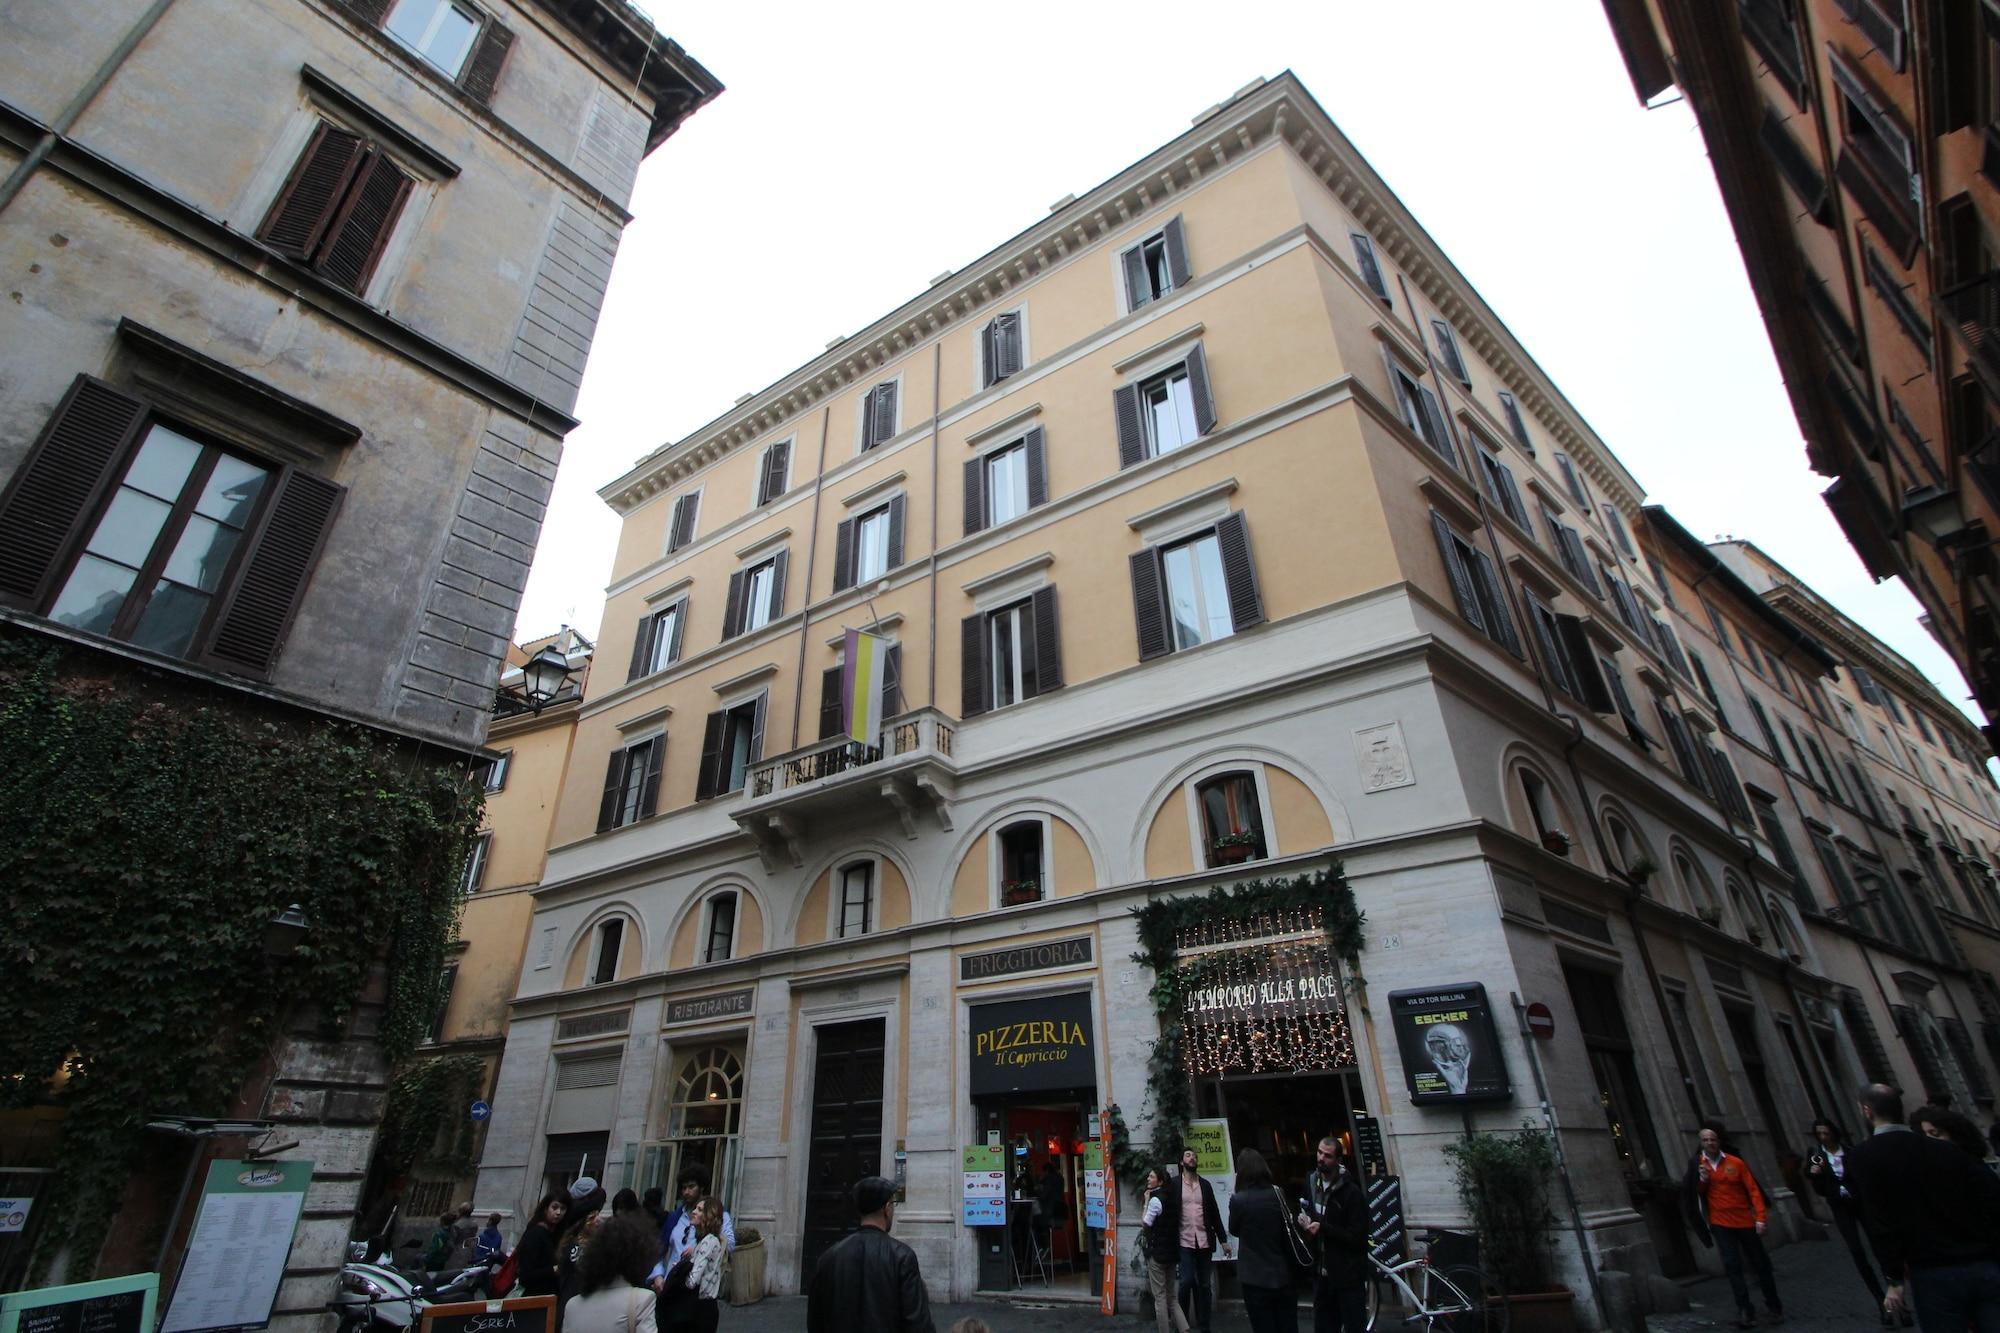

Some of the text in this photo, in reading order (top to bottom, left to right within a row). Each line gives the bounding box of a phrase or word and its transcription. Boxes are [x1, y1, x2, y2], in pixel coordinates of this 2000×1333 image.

[1382, 935, 1400, 949] 28
[969, 942, 1086, 976] FRIGGITORIA
[1187, 976, 1336, 1011] L'EMPORIO ALLA PACE
[1426, 996, 1439, 1004] TOR
[1440, 994, 1466, 1002] MILLINA
[673, 995, 747, 1019] RISTORANTE
[1414, 1011, 1469, 1025] ESCHER
[977, 1021, 1087, 1056] PIZZERIA
[995, 1047, 1067, 1068] Il Capriccio
[1186, 1127, 1221, 1142] Emporio
